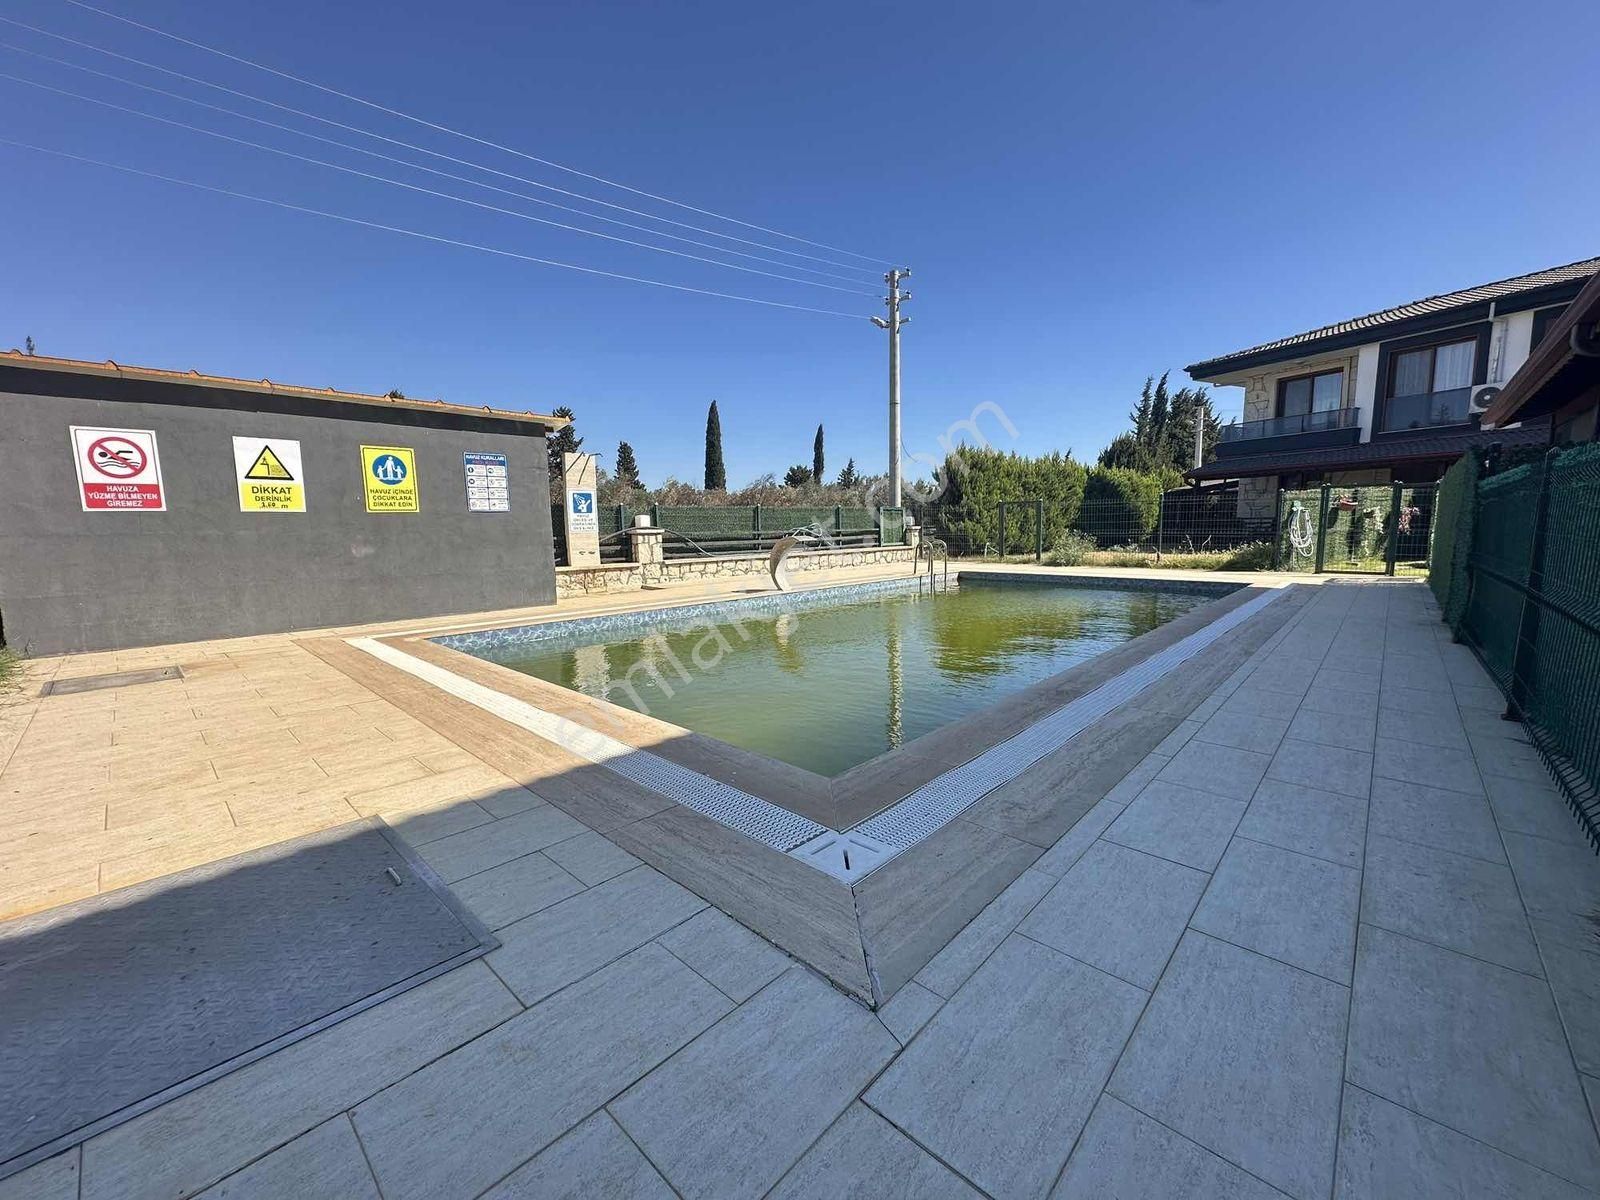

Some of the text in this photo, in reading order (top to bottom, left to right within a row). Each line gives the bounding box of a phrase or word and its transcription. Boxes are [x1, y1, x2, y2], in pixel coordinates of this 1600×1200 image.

[251, 484, 293, 494] DİKKAT
[118, 492, 158, 500] BİLMEYEN
[106, 499, 143, 507] GİREMEZ
